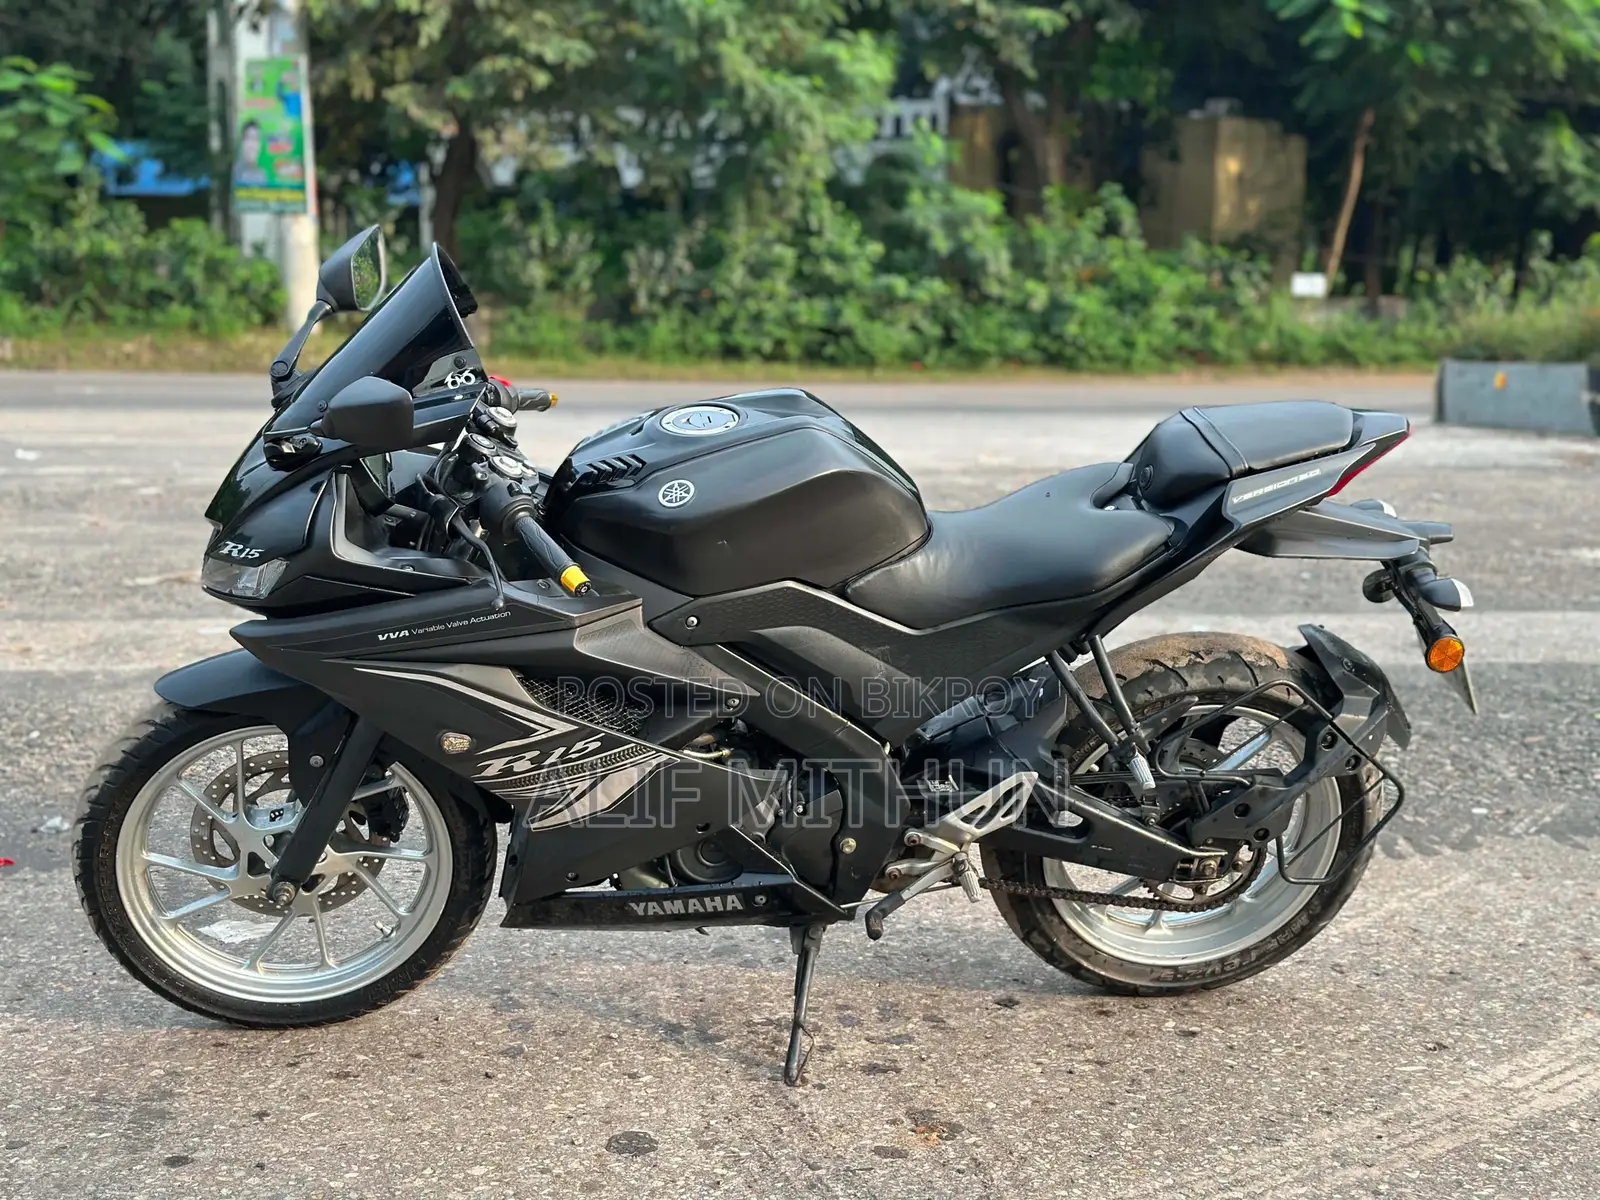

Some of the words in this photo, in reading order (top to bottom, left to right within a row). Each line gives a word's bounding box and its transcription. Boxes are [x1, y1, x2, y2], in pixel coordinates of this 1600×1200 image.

[218, 540, 265, 559] R15
[377, 629, 410, 641] VVA
[410, 624, 445, 635] Variable
[445, 620, 468, 629] Valve
[469, 610, 511, 624] Actuation
[471, 732, 606, 778] R15
[628, 894, 744, 916] YAMAHA
